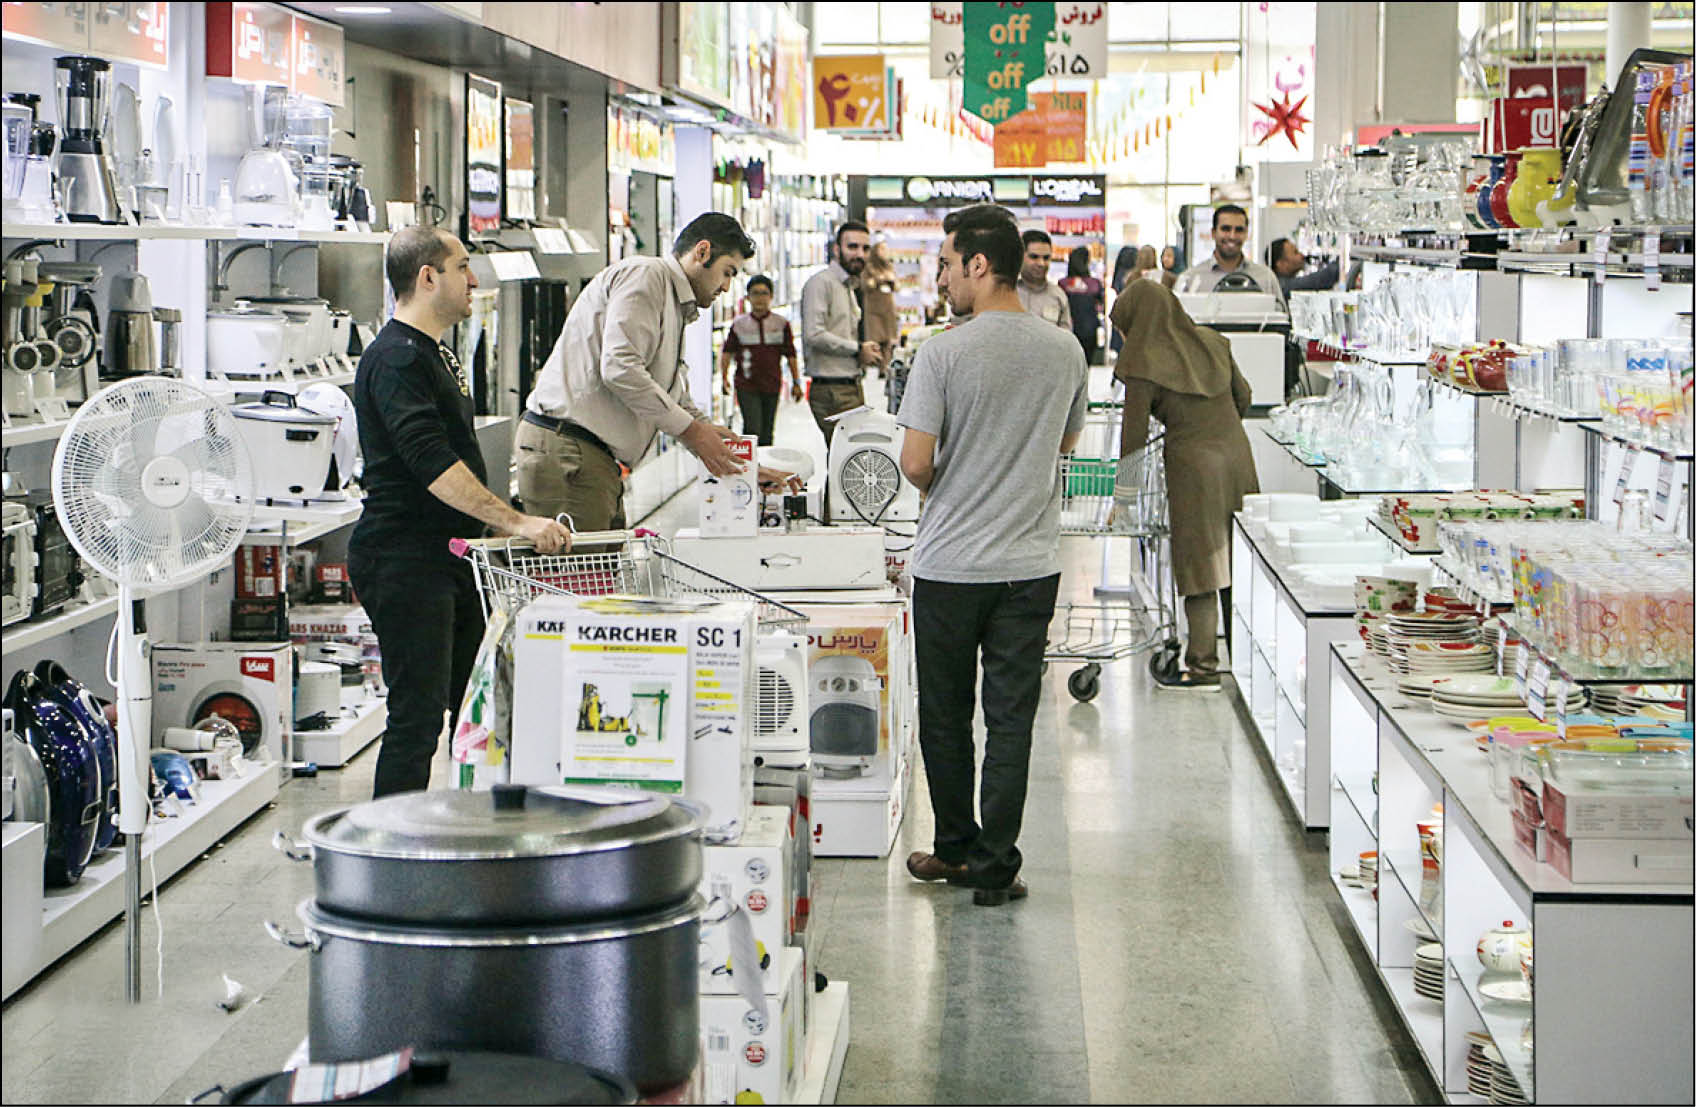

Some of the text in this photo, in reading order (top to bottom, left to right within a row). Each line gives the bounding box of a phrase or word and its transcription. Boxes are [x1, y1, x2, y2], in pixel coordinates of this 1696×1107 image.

[989, 14, 1031, 44] off
[987, 63, 1025, 89] off
[980, 97, 1011, 119] off
[310, 623, 348, 634] KHAZAR
[578, 625, 678, 643] KÄRCHER
[696, 626, 742, 649] SC 1
